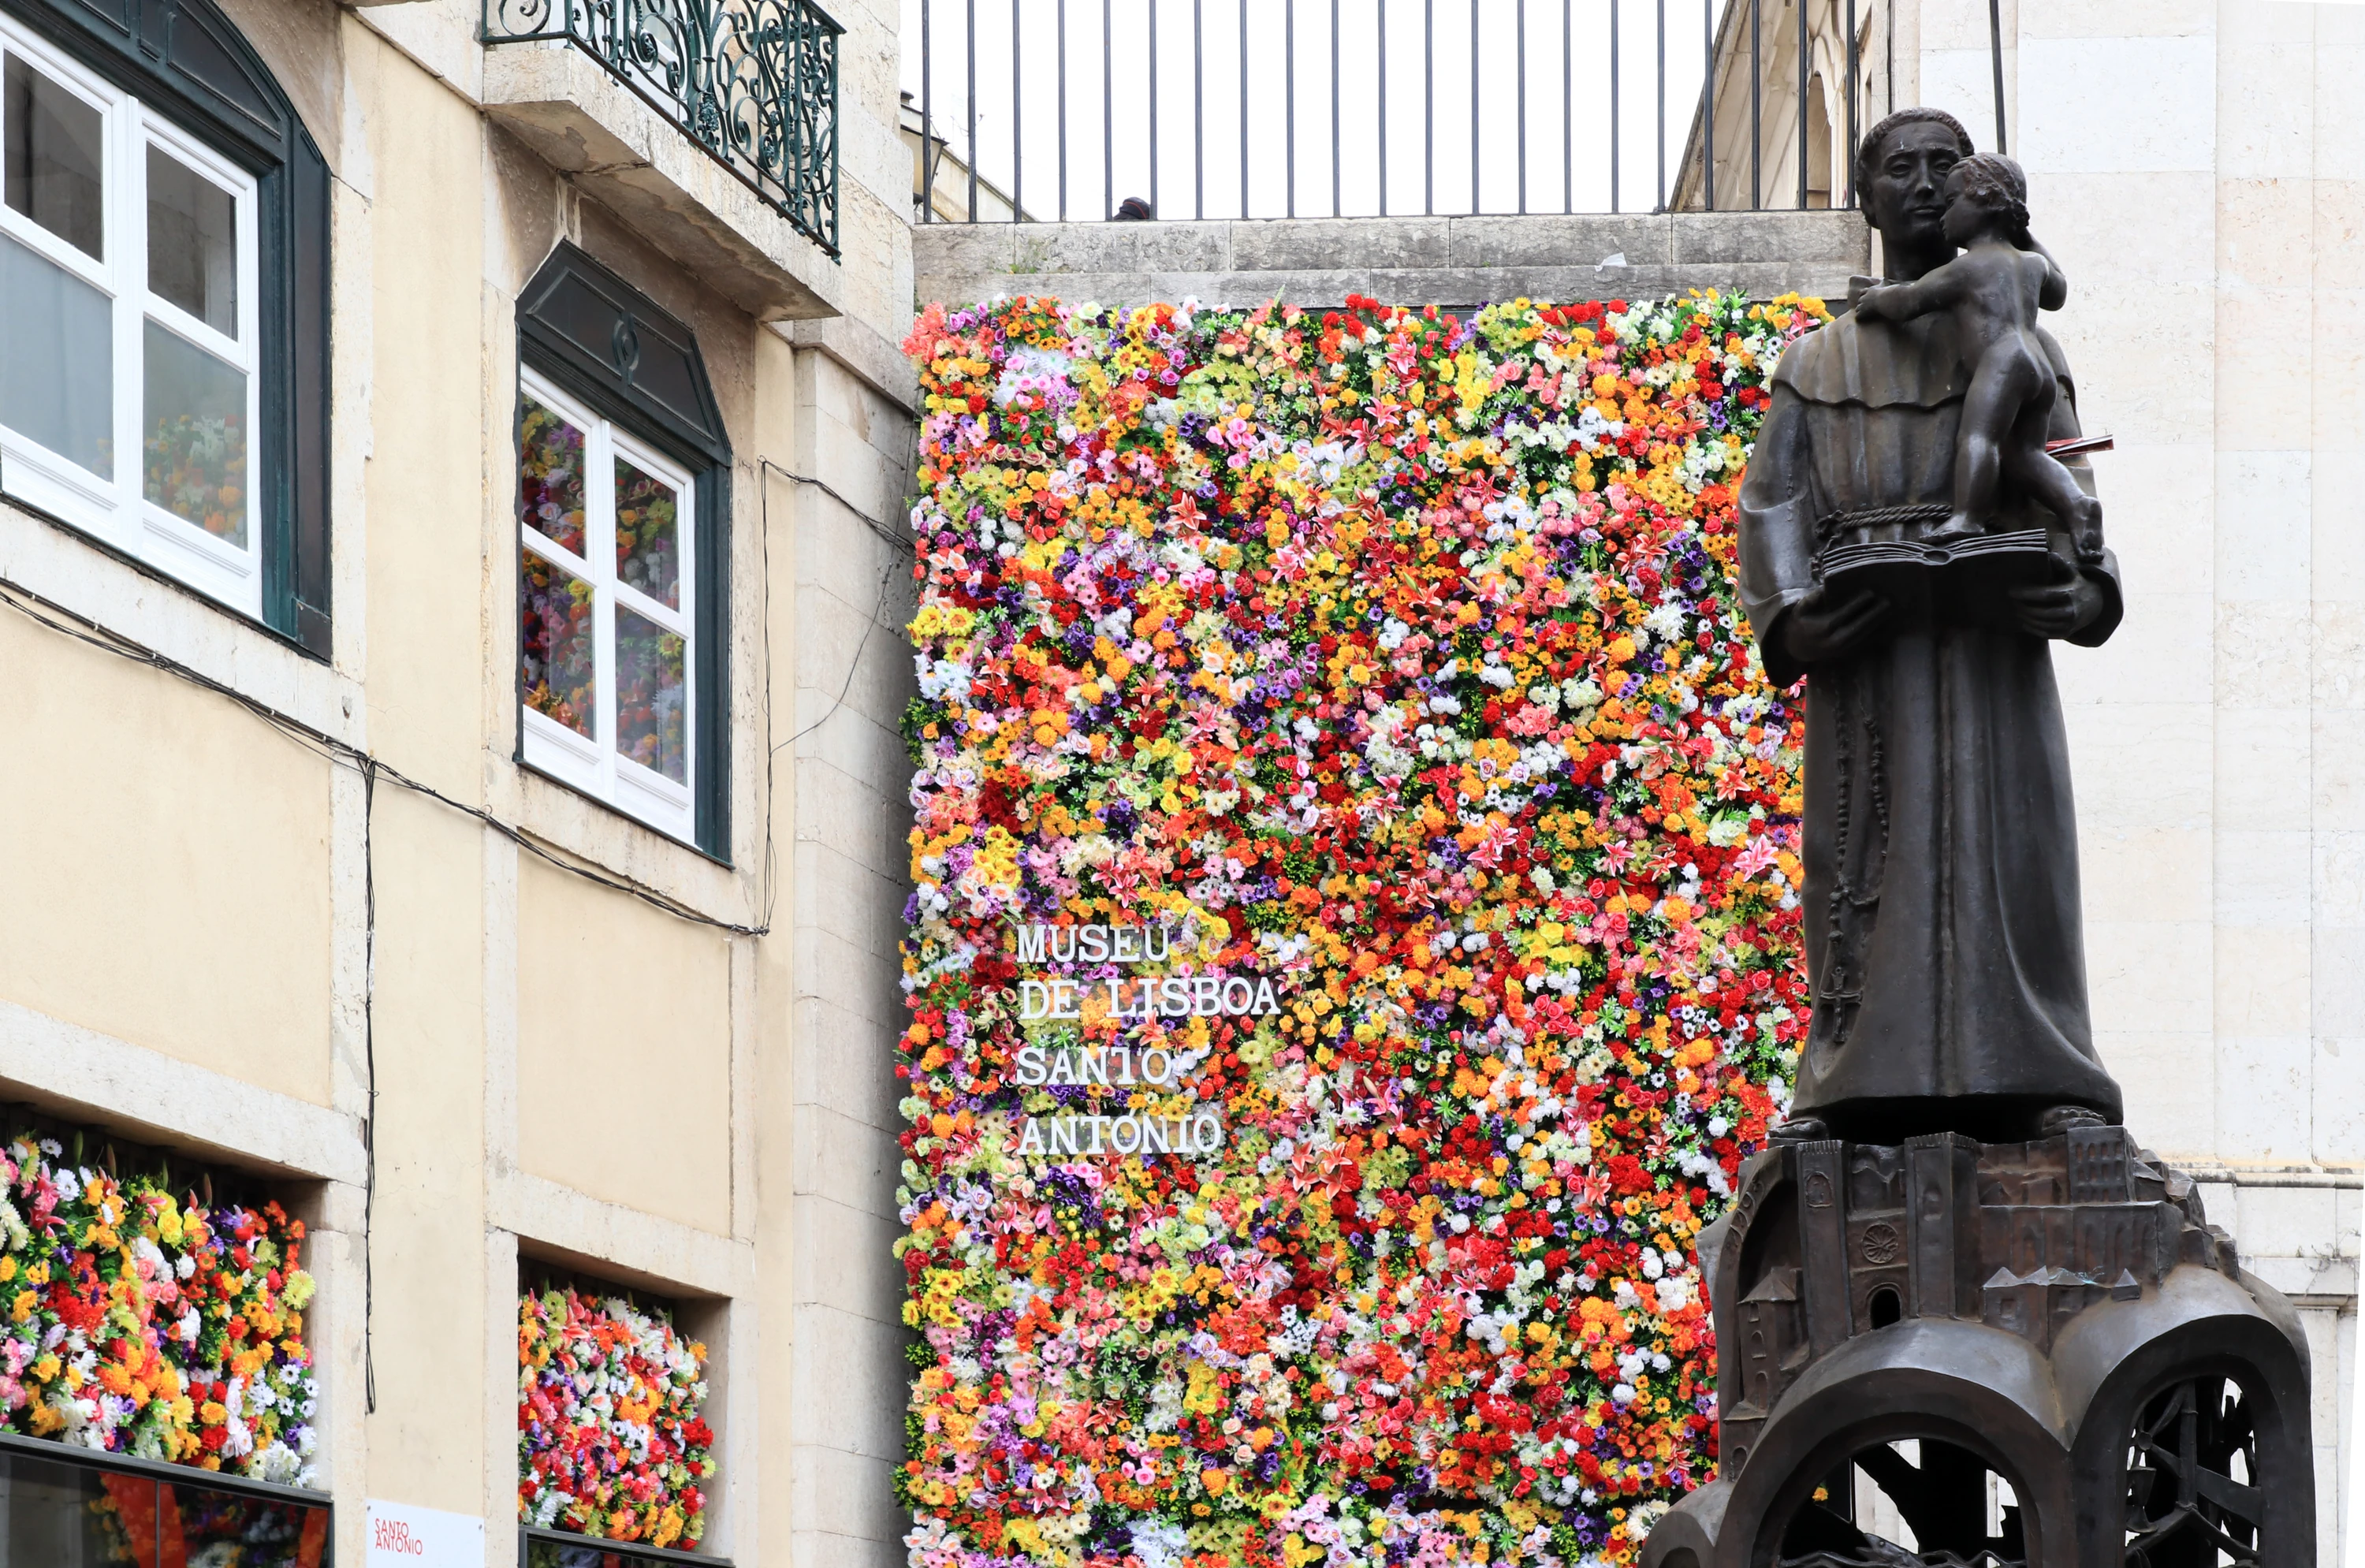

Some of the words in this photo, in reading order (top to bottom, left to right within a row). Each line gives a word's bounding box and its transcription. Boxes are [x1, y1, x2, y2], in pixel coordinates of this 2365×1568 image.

[1017, 924, 1169, 963] MUSEU
[1020, 981, 1079, 1019] DE
[1106, 977, 1281, 1017] LISBOA
[1016, 1046, 1171, 1086] SANTO
[374, 1518, 409, 1539] SANTO
